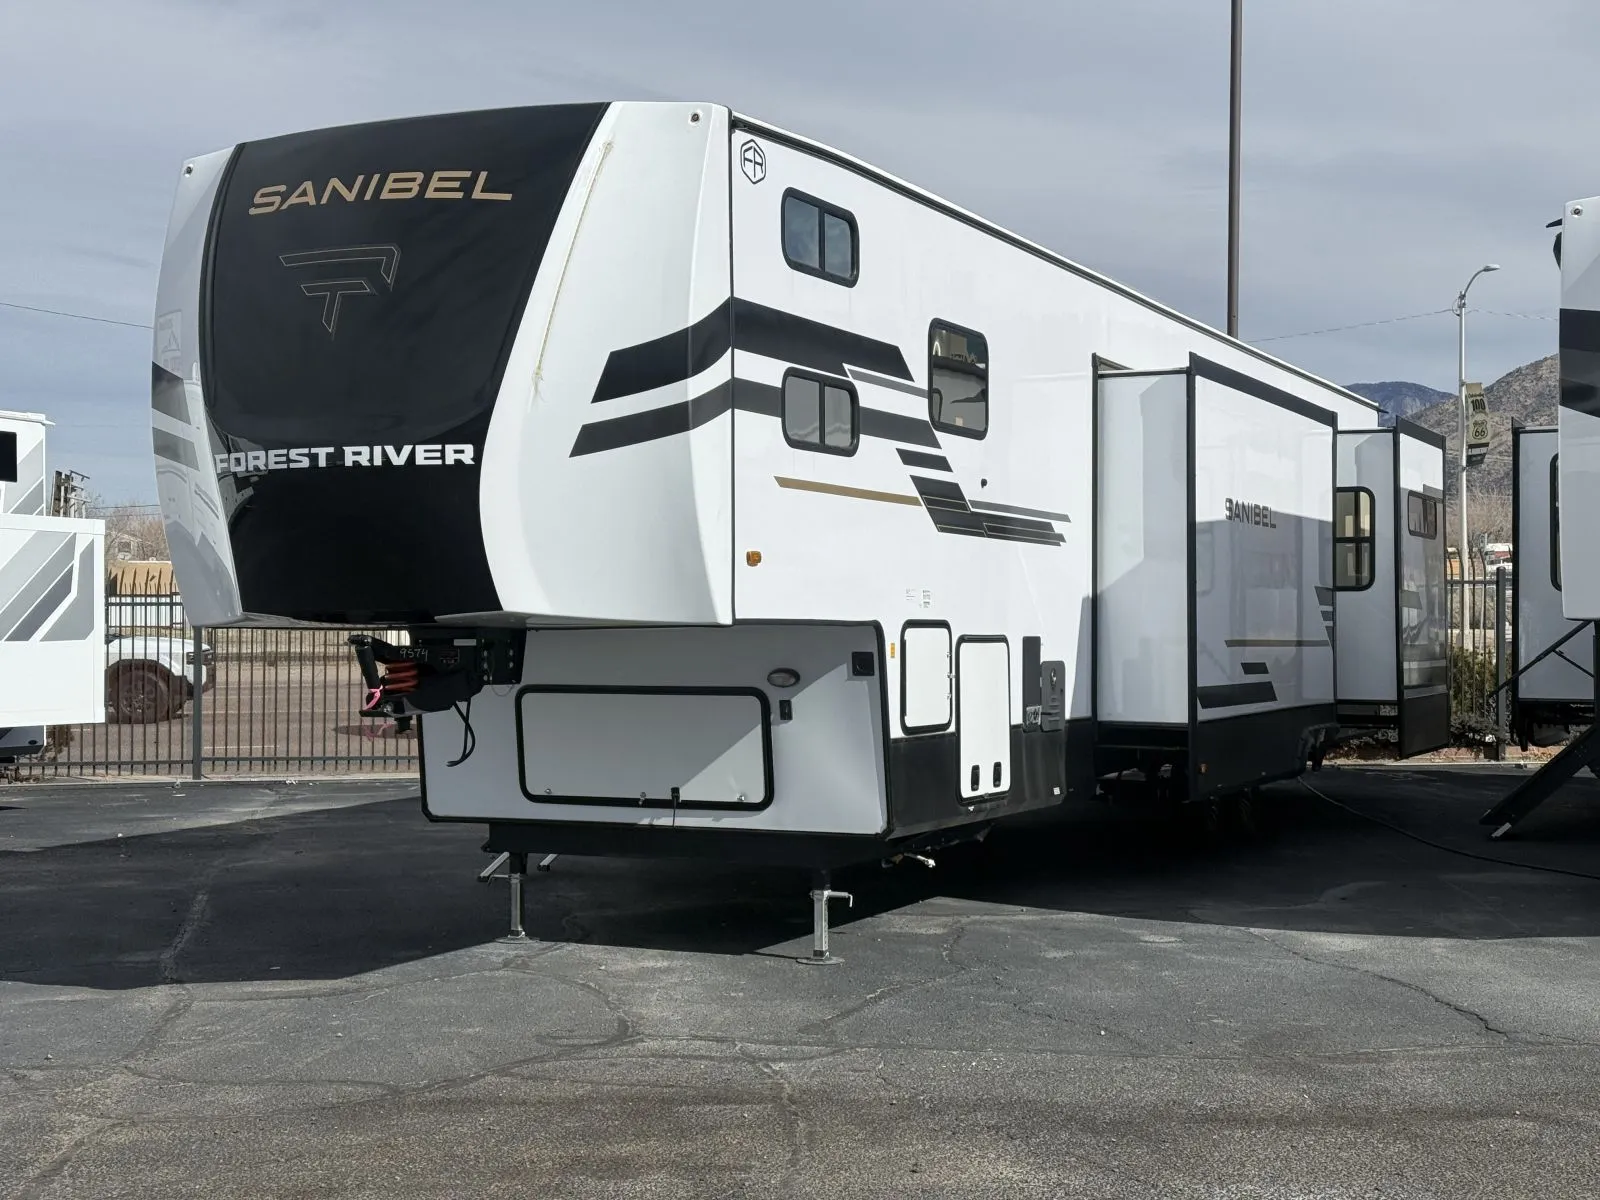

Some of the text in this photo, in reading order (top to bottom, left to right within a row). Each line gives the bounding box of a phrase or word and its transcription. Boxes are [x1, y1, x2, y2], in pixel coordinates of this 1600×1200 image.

[248, 170, 513, 215] SANIBEL
[1471, 398, 1486, 411] 100
[1474, 427, 1486, 437] 66
[214, 443, 475, 474] FOREST RIVER
[1225, 497, 1277, 529] SANIBEL
[400, 648, 429, 663] 9574
